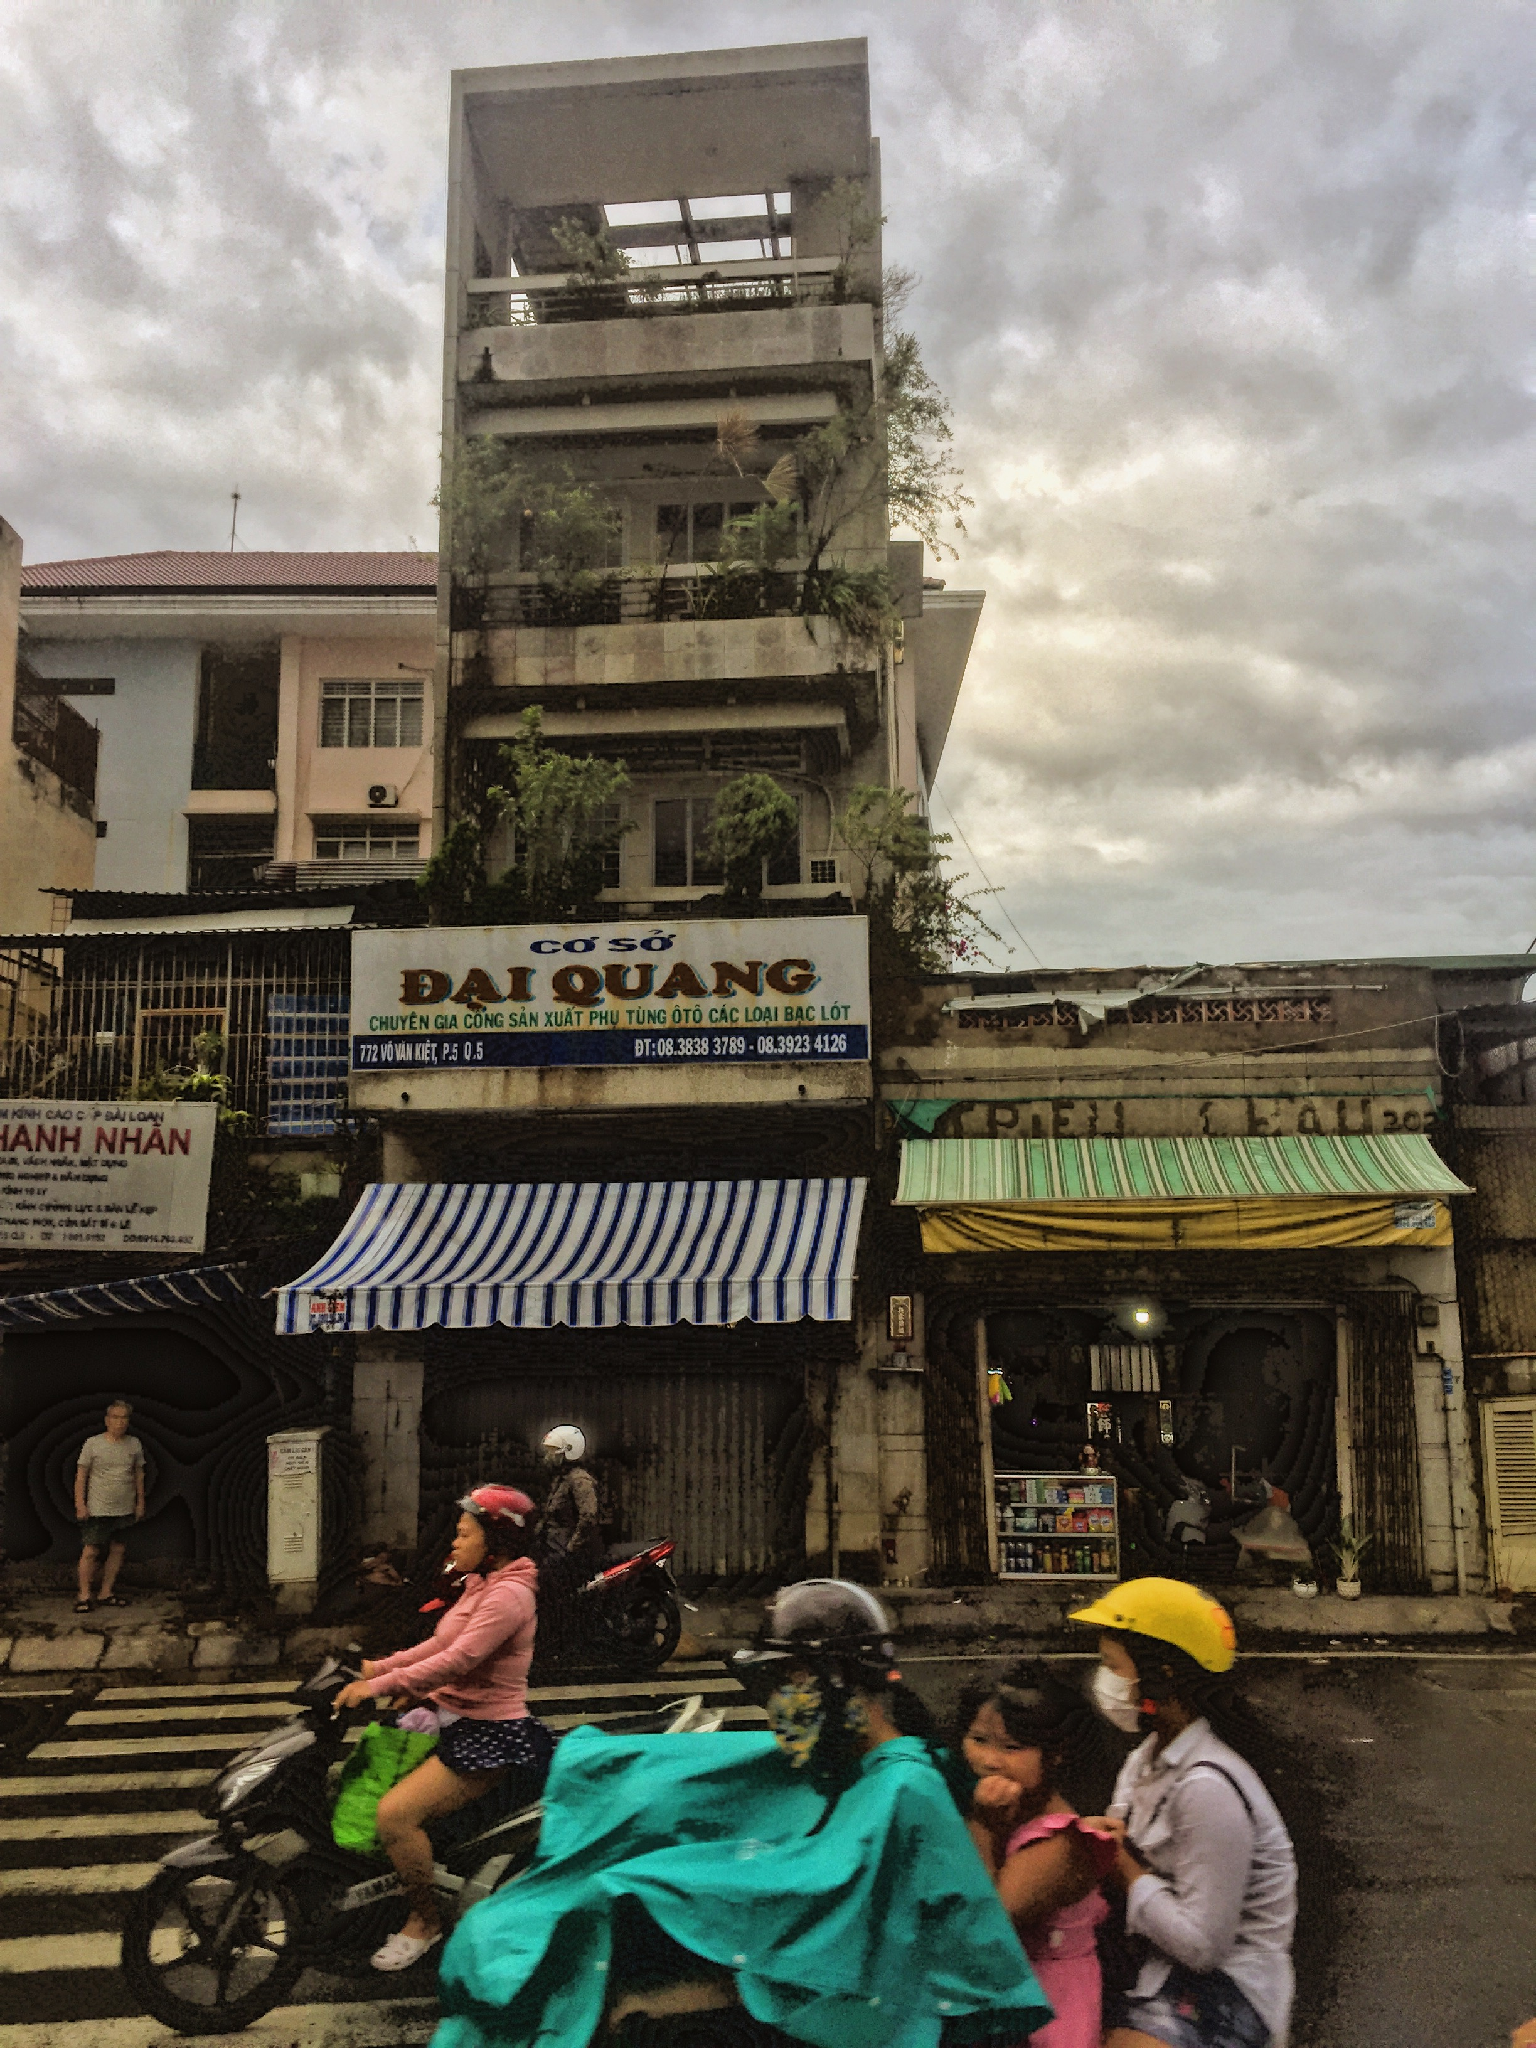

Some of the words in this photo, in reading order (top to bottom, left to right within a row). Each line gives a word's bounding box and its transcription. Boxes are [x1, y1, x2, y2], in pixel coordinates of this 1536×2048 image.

[529, 936, 600, 954] CƠ
[607, 929, 677, 952] SỞ
[398, 966, 537, 1011] ĐẠI
[551, 958, 823, 1008] QUANG
[369, 1011, 430, 1031] CHUYÊN
[434, 1014, 458, 1030] GIA
[508, 1006, 539, 1028] SẢN
[544, 1006, 584, 1027] XUẤT
[626, 1006, 667, 1026] TÙNG
[671, 1004, 704, 1024] ÔTÔ
[708, 1004, 740, 1024] CÁC
[820, 1001, 851, 1021] LÓT
[360, 1044, 379, 1063] 772
[394, 1040, 413, 1061] VĂN
[442, 1042, 459, 1061] P.5
[712, 1036, 746, 1055] 3789
[757, 1034, 811, 1054] 08.3923
[813, 1033, 847, 1053] 4126
